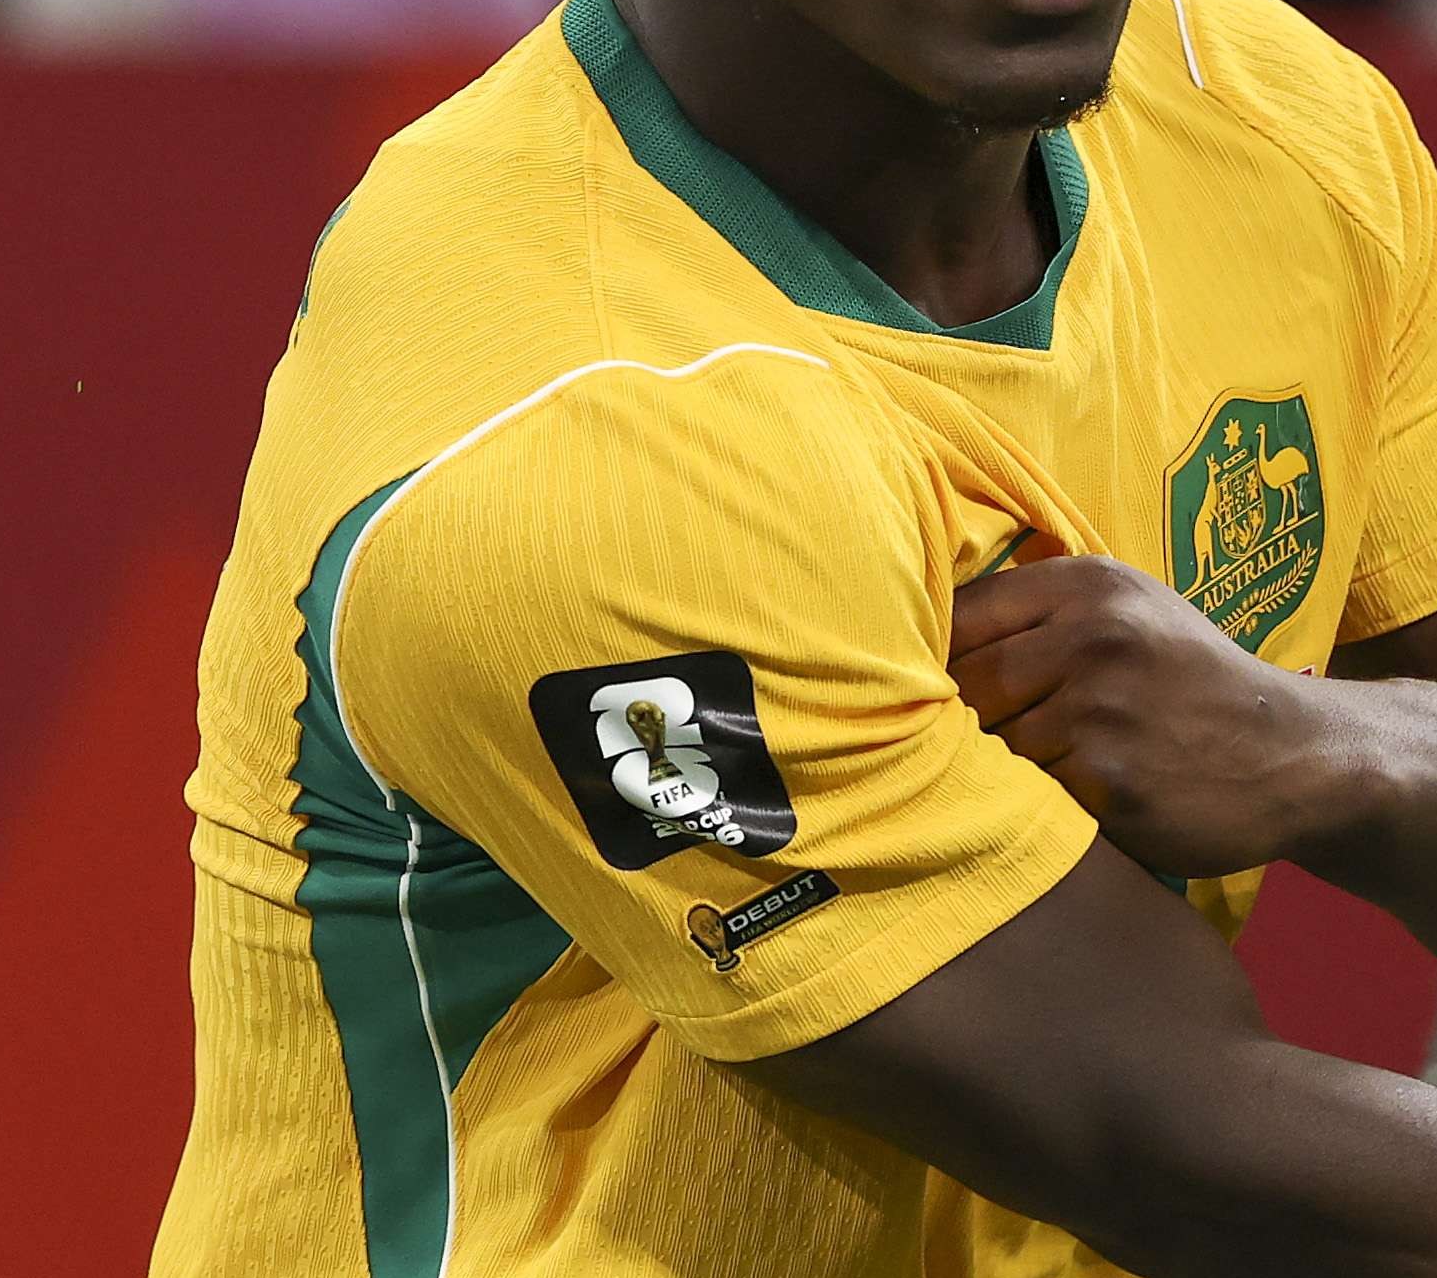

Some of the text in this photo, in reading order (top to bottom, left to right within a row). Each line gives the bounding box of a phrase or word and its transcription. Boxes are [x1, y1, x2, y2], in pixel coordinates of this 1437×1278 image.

[1202, 533, 1301, 616] AUSTRALIA
[650, 782, 694, 809] FIFA
[700, 807, 733, 829] CUP
[727, 874, 815, 933] DEBUT
